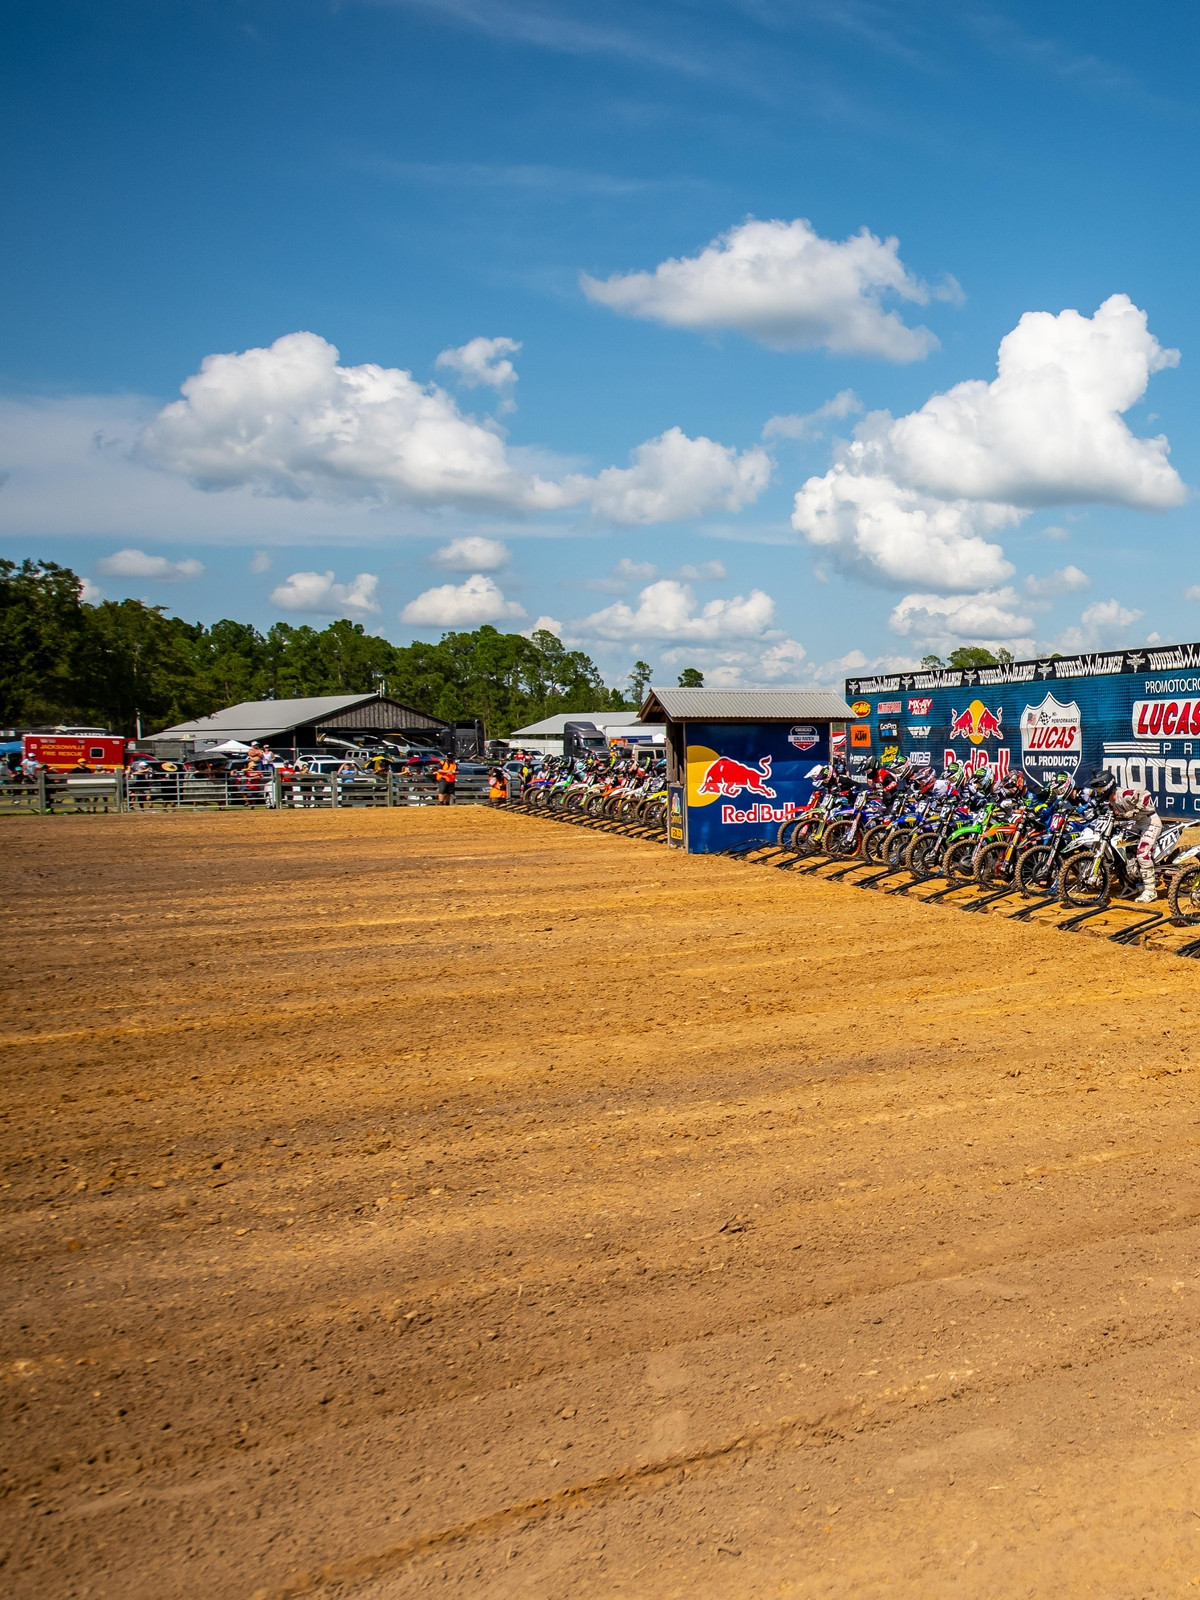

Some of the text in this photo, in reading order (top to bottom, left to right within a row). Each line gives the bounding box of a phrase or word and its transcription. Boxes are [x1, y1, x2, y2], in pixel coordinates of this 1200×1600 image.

[1029, 726, 1077, 749] LUCAS
[1025, 755, 1078, 767] OIL PRODUCTS
[722, 803, 758, 824] Red
